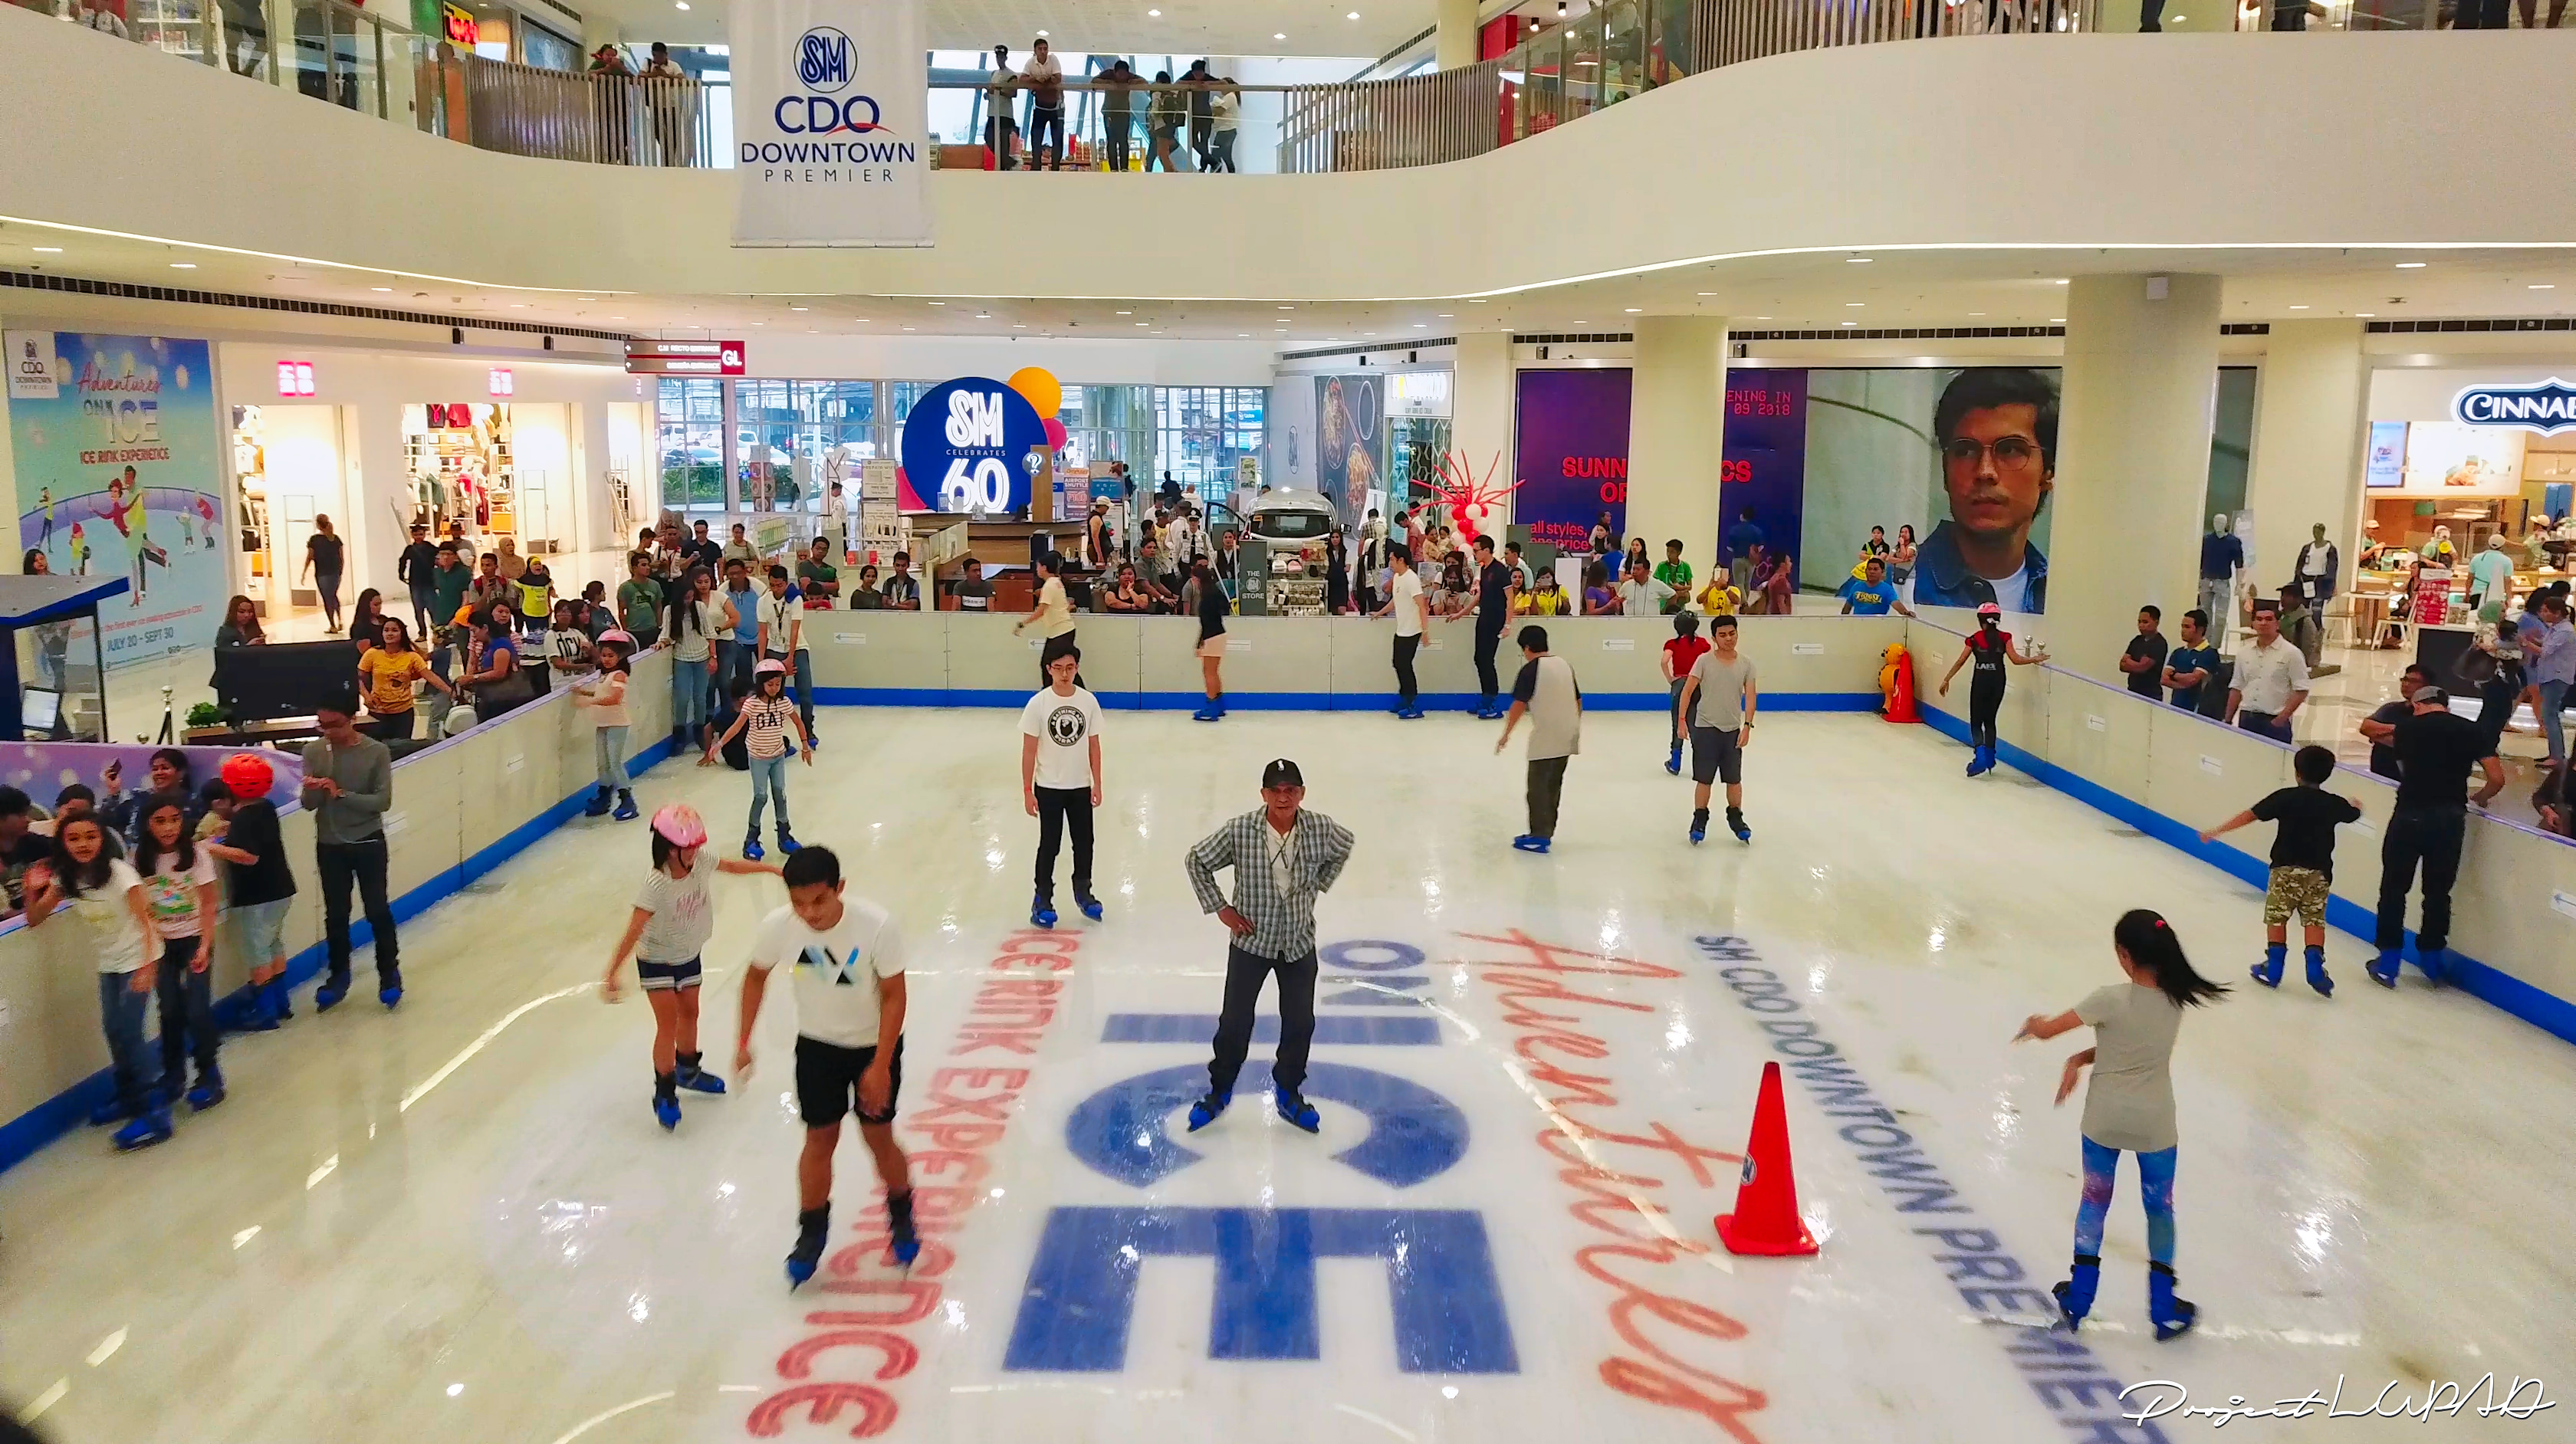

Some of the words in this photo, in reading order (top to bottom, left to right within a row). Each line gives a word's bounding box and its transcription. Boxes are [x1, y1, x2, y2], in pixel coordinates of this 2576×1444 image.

[800, 34, 847, 84] SM
[741, 142, 915, 163] DOWNTOWN
[765, 169, 893, 182] PREMIER
[721, 350, 742, 366] GL
[78, 362, 161, 393] Adventures
[1727, 389, 1766, 402] ENING
[1776, 392, 1791, 403] IN
[1734, 402, 1750, 415] 09
[1757, 403, 1790, 415] 2018
[104, 399, 161, 444] ICE
[945, 389, 1004, 447] SM
[80, 450, 95, 464] ICE
[97, 449, 119, 463] RINK
[120, 447, 170, 462] EXPERIENCE
[1562, 457, 1627, 478] SUNN
[1720, 460, 1752, 482] CS
[941, 458, 1010, 513] 60
[1530, 520, 1545, 534] all
[1546, 521, 1588, 538] styles,
[107, 638, 125, 651] JULY
[127, 635, 138, 648] 20
[144, 629, 163, 643] SEPT
[163, 627, 174, 639] 30
[756, 711, 785, 730] GAP
[991, 930, 1083, 970] ICE
[1319, 939, 1435, 1008] ON
[948, 979, 1065, 1055] RINK
[1695, 935, 1763, 962] SM
[1756, 1021, 1975, 1214] DOWNTOWN
[1001, 1012, 1522, 1375] ICE
[1449, 927, 1768, 1444] Adventures
